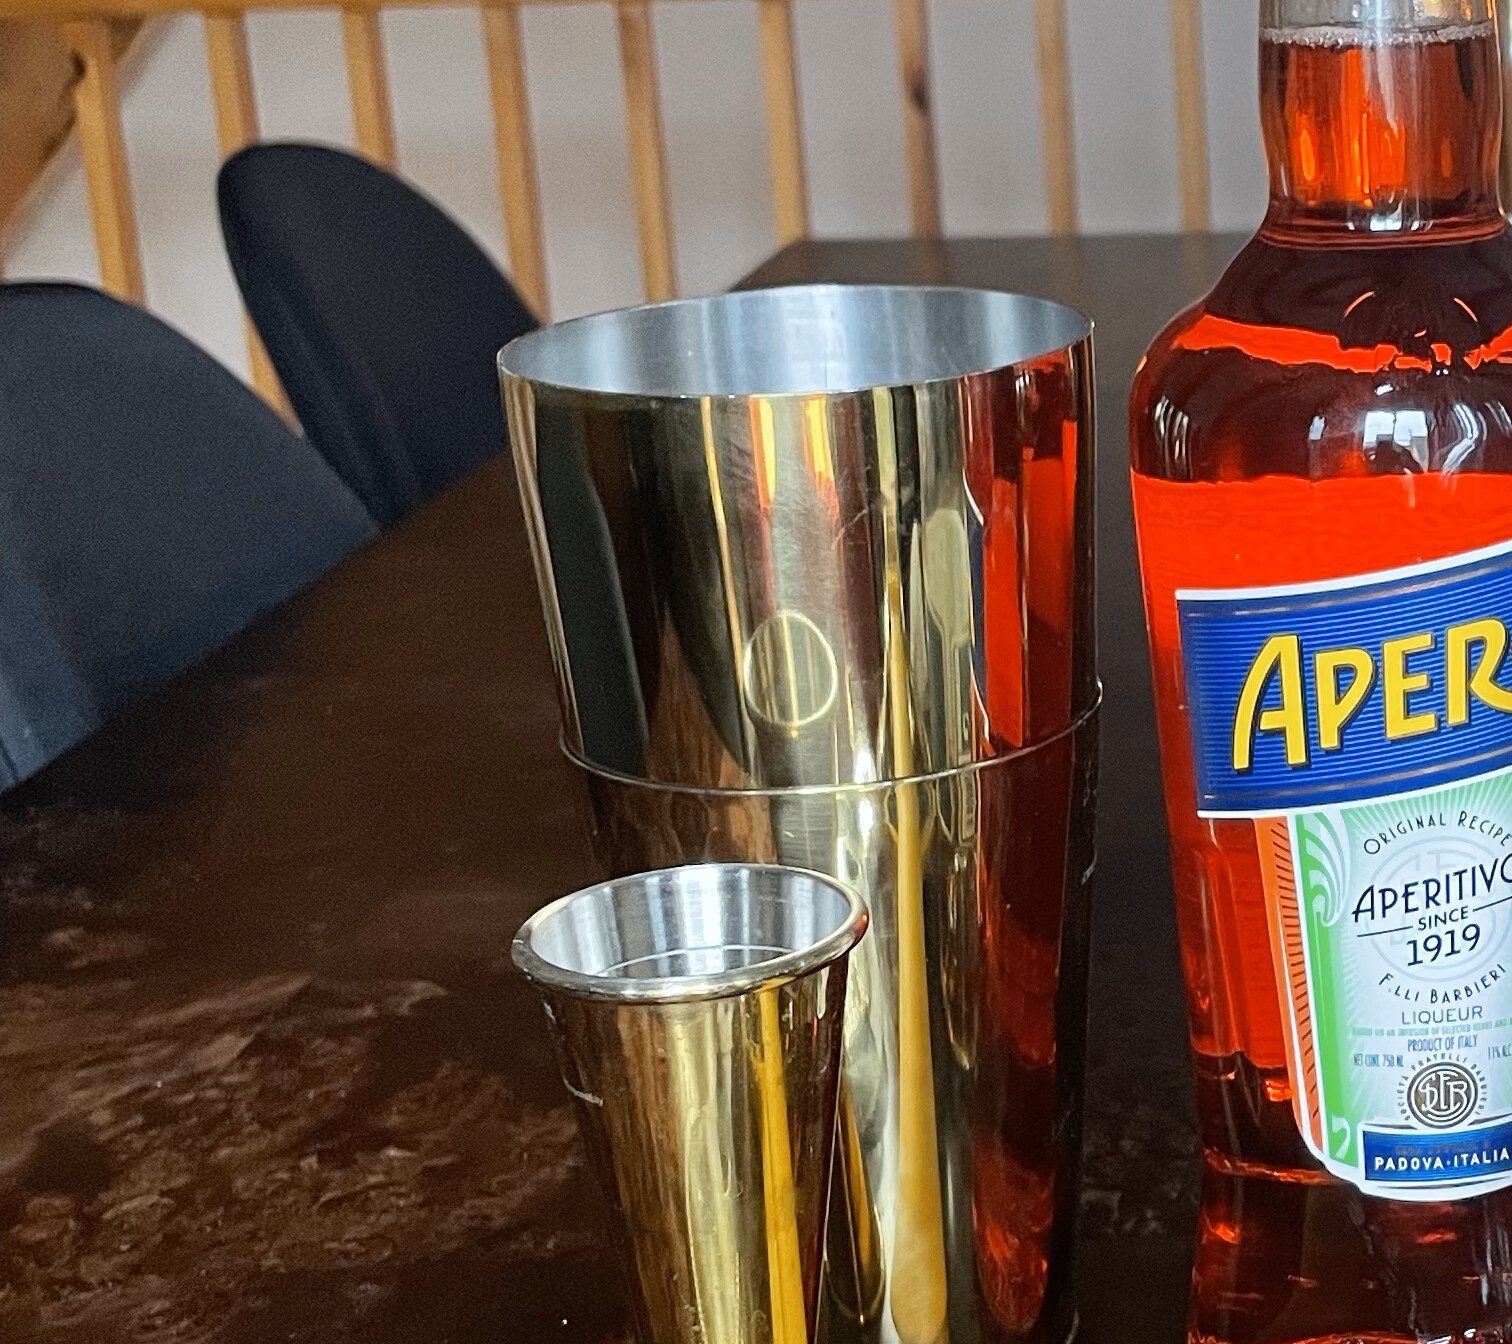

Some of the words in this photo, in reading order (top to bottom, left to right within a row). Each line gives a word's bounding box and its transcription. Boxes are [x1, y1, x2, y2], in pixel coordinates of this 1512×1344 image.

[1363, 812, 1446, 855] ORIGINAL
[1457, 810, 1512, 847] RECIPE
[1417, 905, 1469, 931] SINCE
[1406, 923, 1481, 967] 1919
[1430, 963, 1507, 1004] BARBIERI
[1401, 1005, 1483, 1026] LIQUEUR
[1407, 1037, 1443, 1052] PRODUCT
[1445, 1036, 1455, 1051] OF
[1457, 1034, 1479, 1049] ITALY
